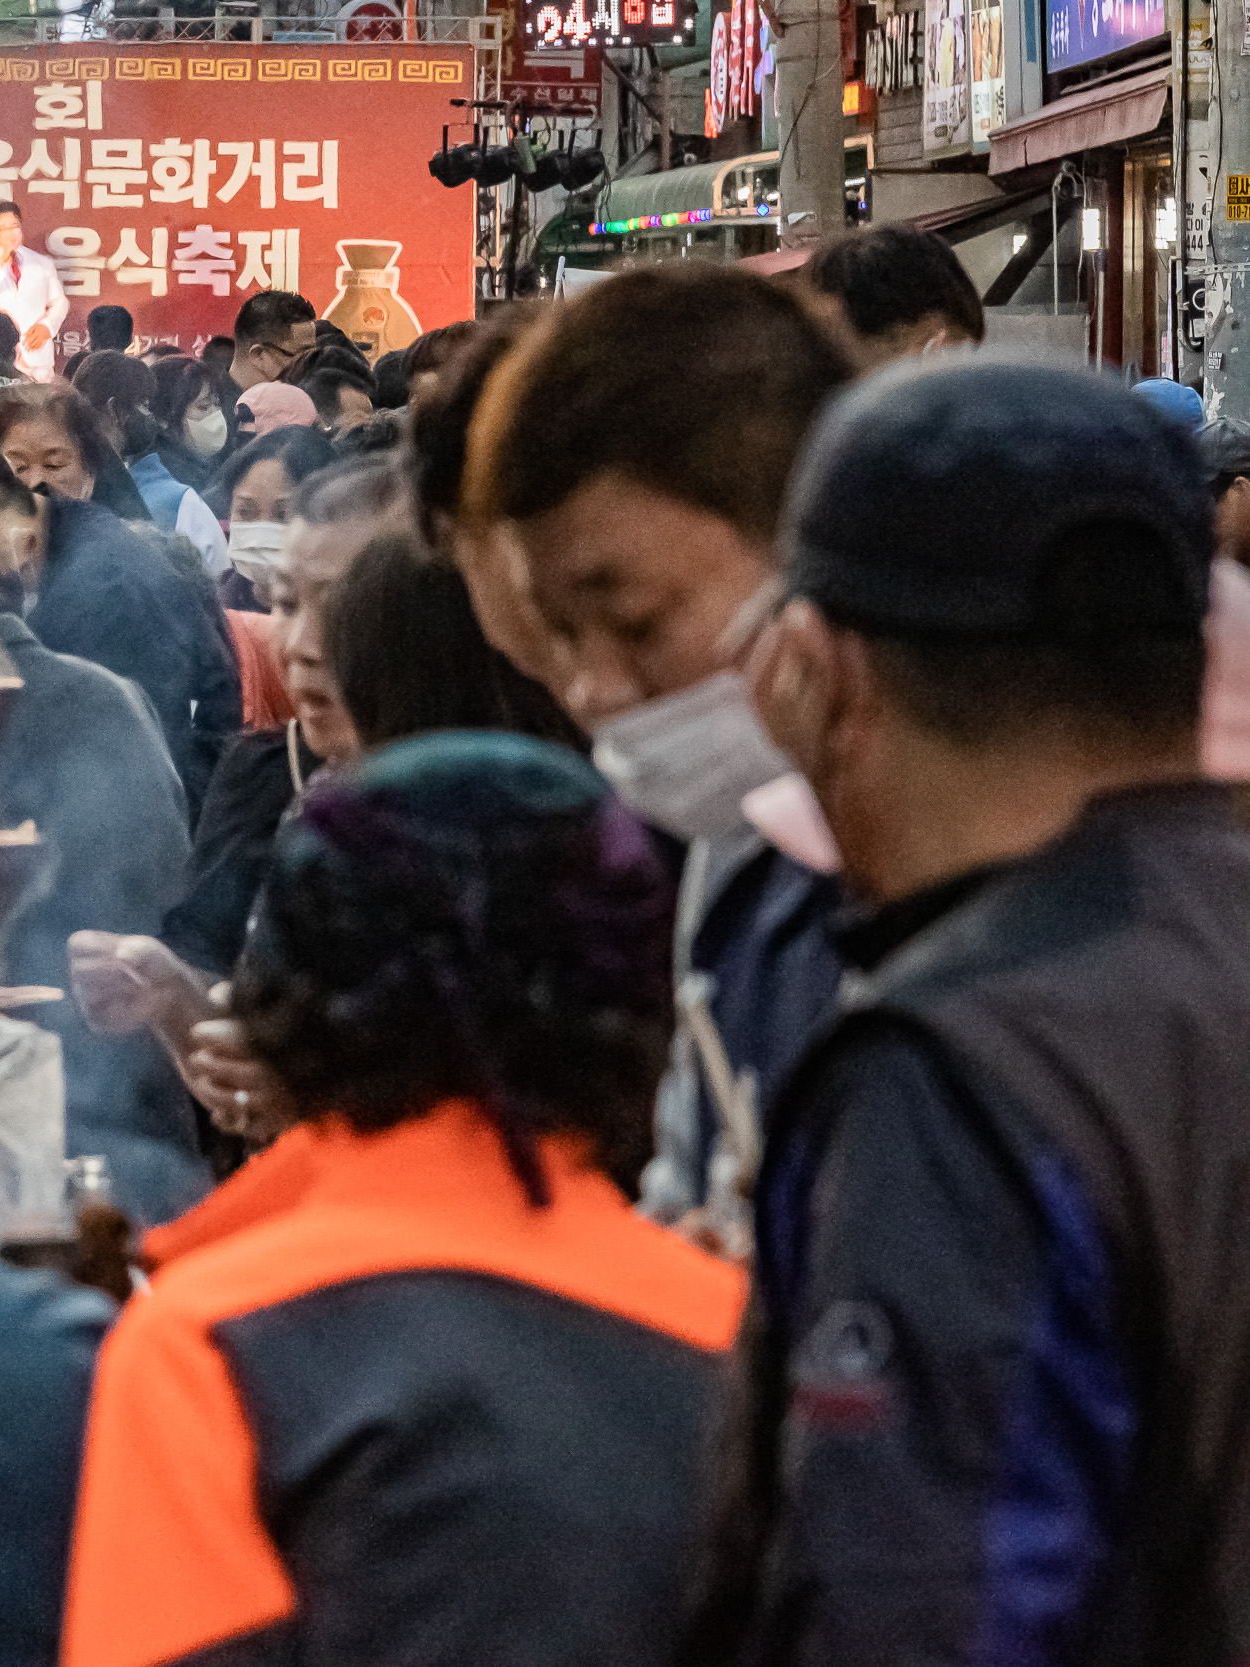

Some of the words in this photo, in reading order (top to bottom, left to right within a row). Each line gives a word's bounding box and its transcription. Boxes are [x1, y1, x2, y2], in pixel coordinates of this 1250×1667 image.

[33, 79, 103, 131] 회
[1228, 204, 1250, 219] 010-7
[47, 224, 301, 298] 음식축제
